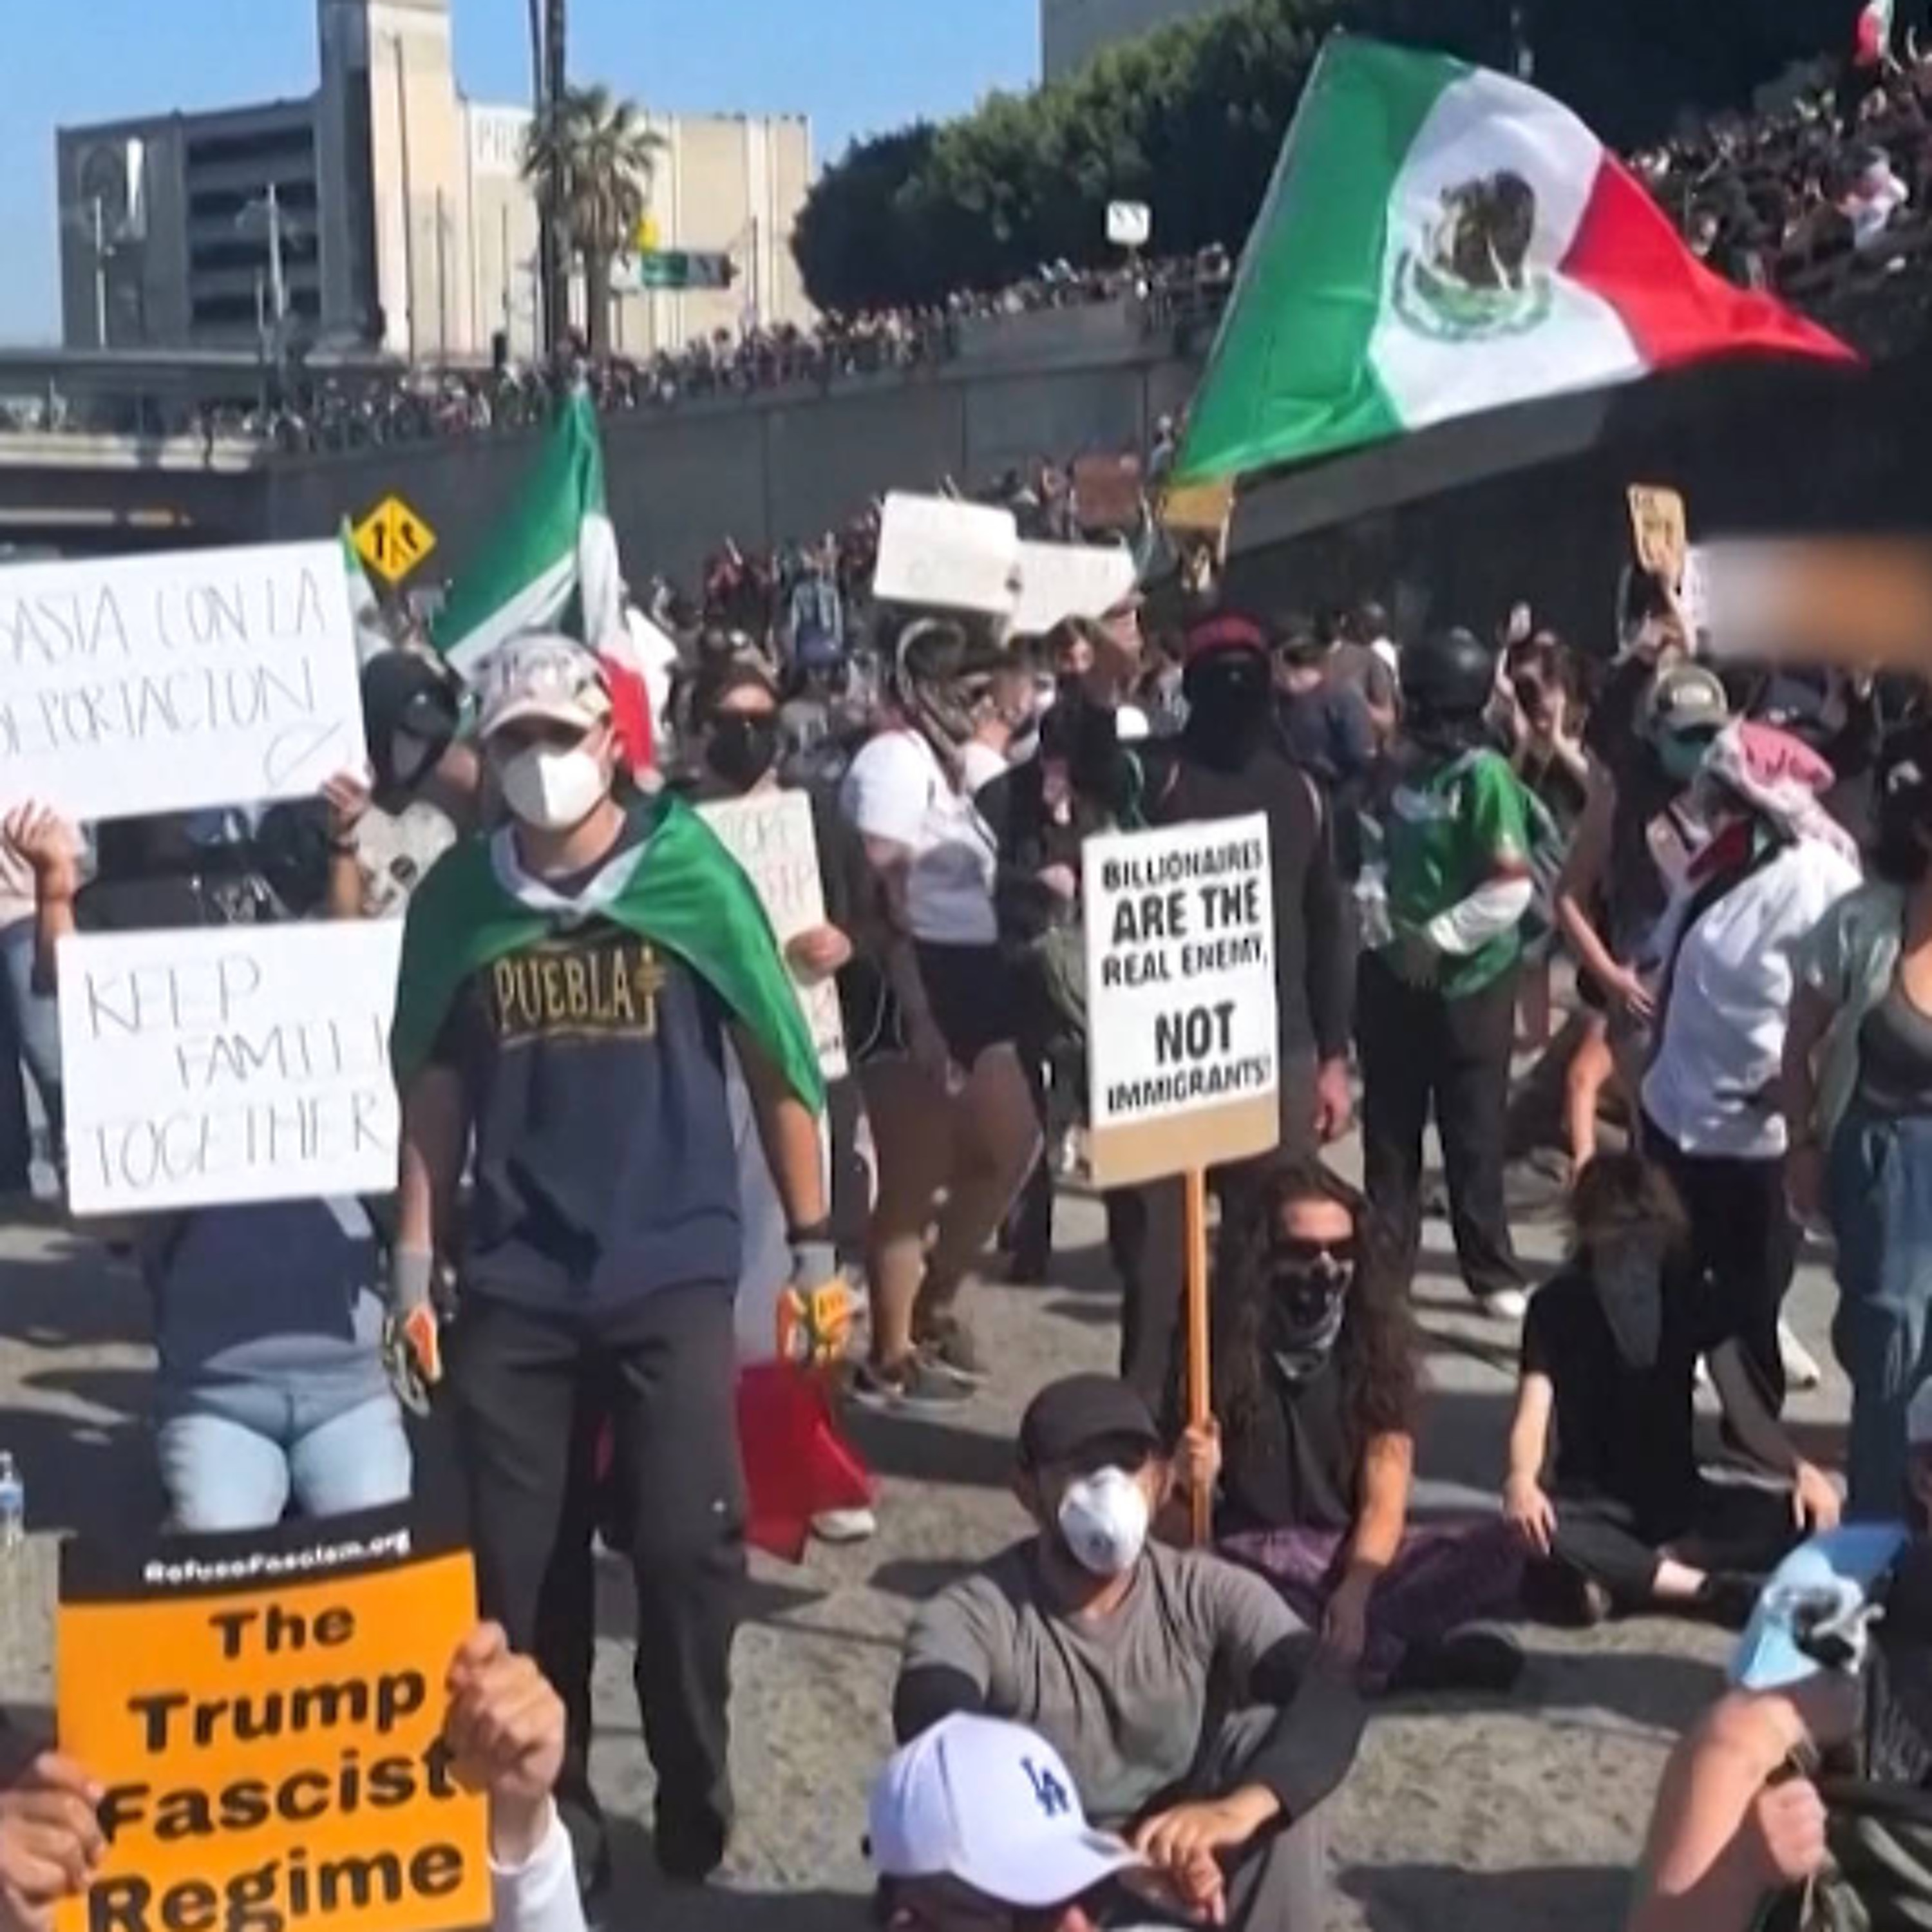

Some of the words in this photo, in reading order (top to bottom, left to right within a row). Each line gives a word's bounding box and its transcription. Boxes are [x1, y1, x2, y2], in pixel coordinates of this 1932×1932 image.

[0, 582, 130, 665] ASTA
[156, 578, 249, 649] CON
[1102, 838, 1263, 894] BILLIONAIRES
[1112, 890, 1188, 947] ARE
[1198, 876, 1260, 930] THE
[85, 953, 261, 1039] KEEP
[493, 947, 636, 1034] PUEBLA
[1101, 948, 1171, 987] REAL
[1154, 999, 1236, 1066] NOT
[92, 1088, 393, 1190] TOGETHER
[209, 1604, 354, 1660] The
[128, 1668, 425, 1754] Trump
[97, 1735, 455, 1844] Fascist
[1021, 1756, 1070, 1817] LA
[88, 1843, 463, 1932] Regime
